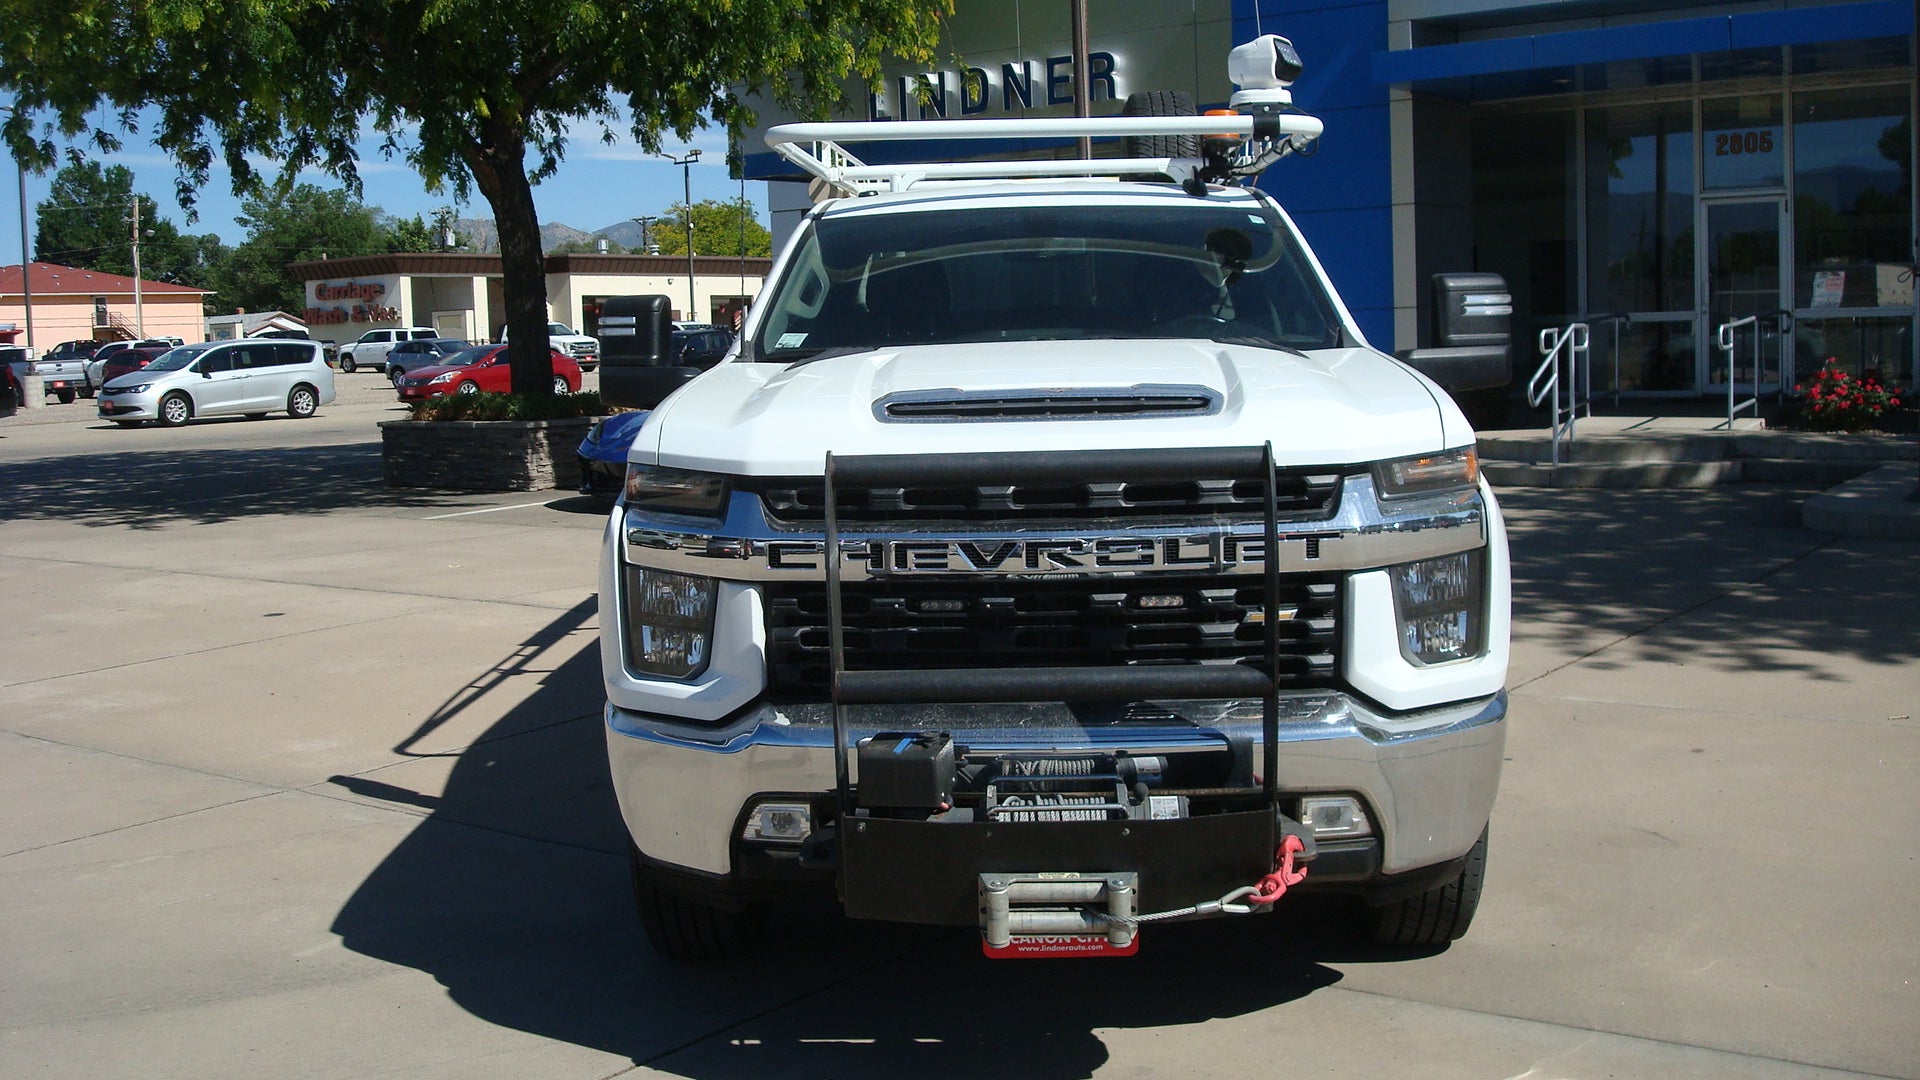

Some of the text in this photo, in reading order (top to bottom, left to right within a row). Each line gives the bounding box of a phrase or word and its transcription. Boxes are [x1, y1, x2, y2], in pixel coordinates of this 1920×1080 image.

[869, 51, 1118, 121] LINDNER
[1715, 130, 1774, 156] 2805
[314, 282, 382, 303] Carriage
[301, 307, 346, 326] Wash
[351, 304, 364, 324] &
[766, 531, 1344, 570] CHEVROLET
[1017, 944, 1104, 952] www.lindnerauto.com
